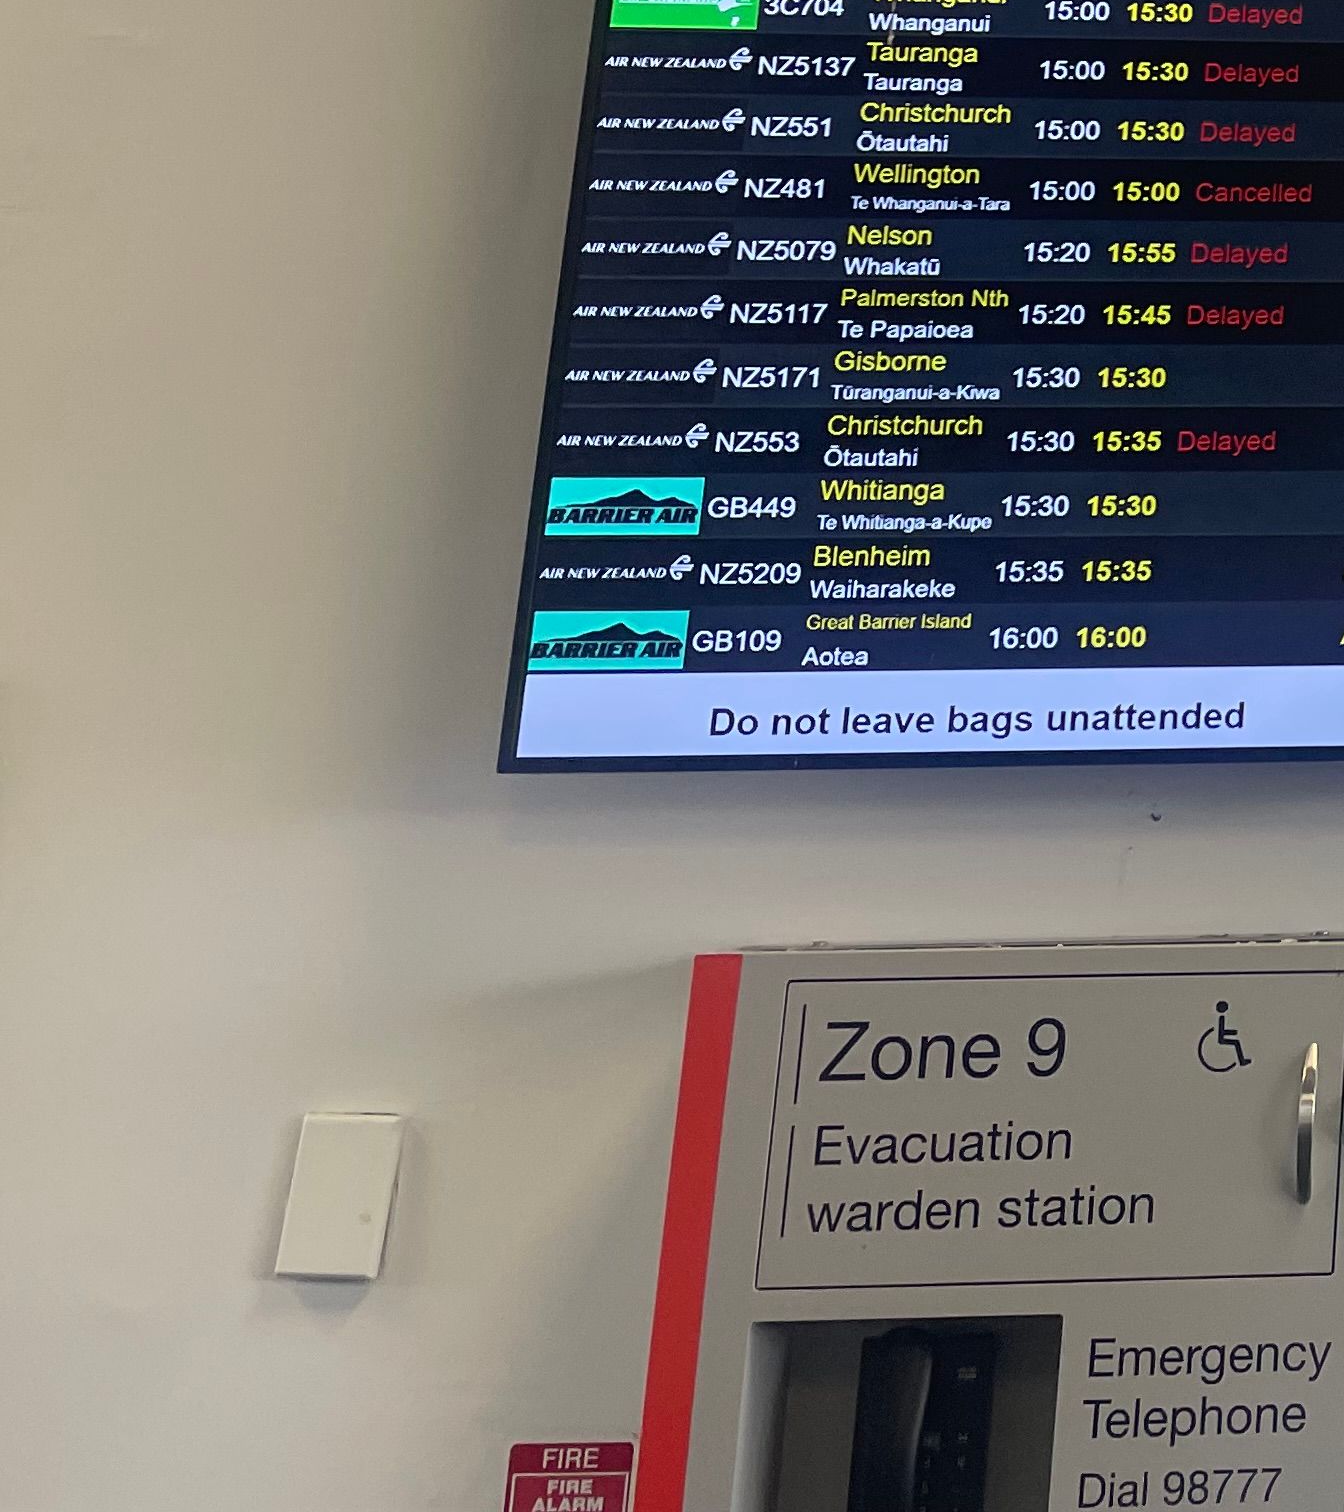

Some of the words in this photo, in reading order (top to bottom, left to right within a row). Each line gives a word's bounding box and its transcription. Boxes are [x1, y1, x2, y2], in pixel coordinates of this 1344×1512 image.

[589, 180, 613, 191] AIR
[616, 180, 648, 191] NEW
[649, 180, 712, 192] ZEALAND
[744, 178, 826, 198] NZ481
[854, 163, 980, 189] Wellington
[1029, 179, 1096, 201] 15:00
[1113, 182, 1180, 201] 15:00
[1196, 182, 1312, 202] Cancelled
[851, 196, 869, 209] Te
[873, 197, 1010, 213] Whanganui-a-Tara
[546, 508, 655, 524] BARRIER
[655, 508, 699, 524] AIR
[708, 496, 797, 519] GB449
[821, 480, 944, 505] Whitianga
[1002, 495, 1070, 517] 15:30
[1088, 495, 1156, 516] 15:30
[817, 514, 837, 530] Te
[842, 513, 992, 533] Whitianga-a-Kupe
[710, 709, 758, 735] Do
[772, 709, 830, 735] not
[842, 707, 934, 734] leave
[948, 706, 1032, 739] bags
[1048, 702, 1244, 731] unattended
[819, 1022, 1000, 1081] Zone
[1027, 1018, 1065, 1076] 9
[815, 1121, 1071, 1165] Evacuation
[808, 1190, 979, 1232] warden
[998, 1185, 1153, 1227] station
[1089, 1338, 1331, 1384] Emergency
[1083, 1396, 1306, 1447] Telephone
[542, 1448, 600, 1469] FIRE
[532, 1497, 604, 1512] ALARM
[547, 1480, 593, 1495] FIRE
[1078, 1472, 1148, 1508] Dial
[1163, 1468, 1282, 1506] 98777
